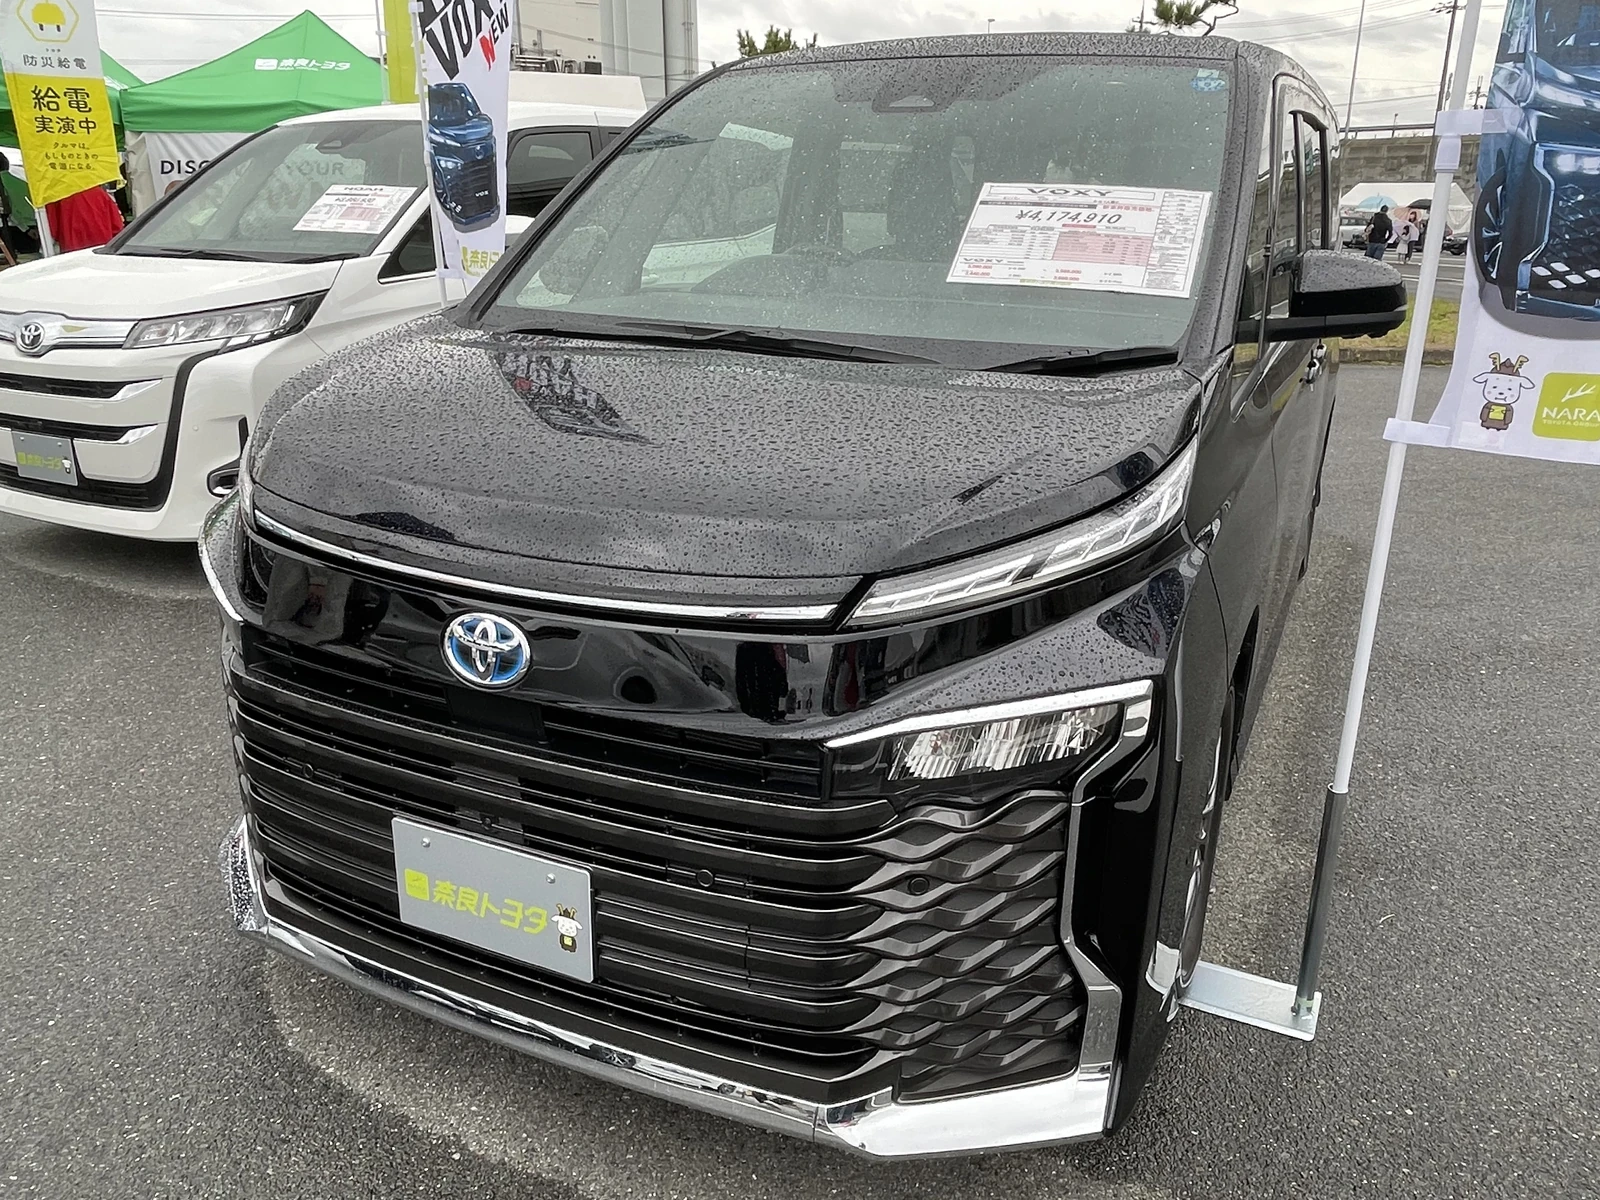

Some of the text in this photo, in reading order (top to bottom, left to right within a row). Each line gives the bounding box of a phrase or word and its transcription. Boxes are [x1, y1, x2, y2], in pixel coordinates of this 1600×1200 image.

[479, 2, 509, 72] NEW
[23, 54, 87, 70] 防災給電
[31, 85, 92, 113] 給電
[35, 115, 97, 135] 実演中
[45, 152, 99, 160] もしものときの
[1026, 187, 1113, 197] VOXY
[1015, 208, 1123, 225] ¥4,174,910
[1542, 407, 1600, 422] NARA
[432, 880, 548, 935] 奈良トヨタ
